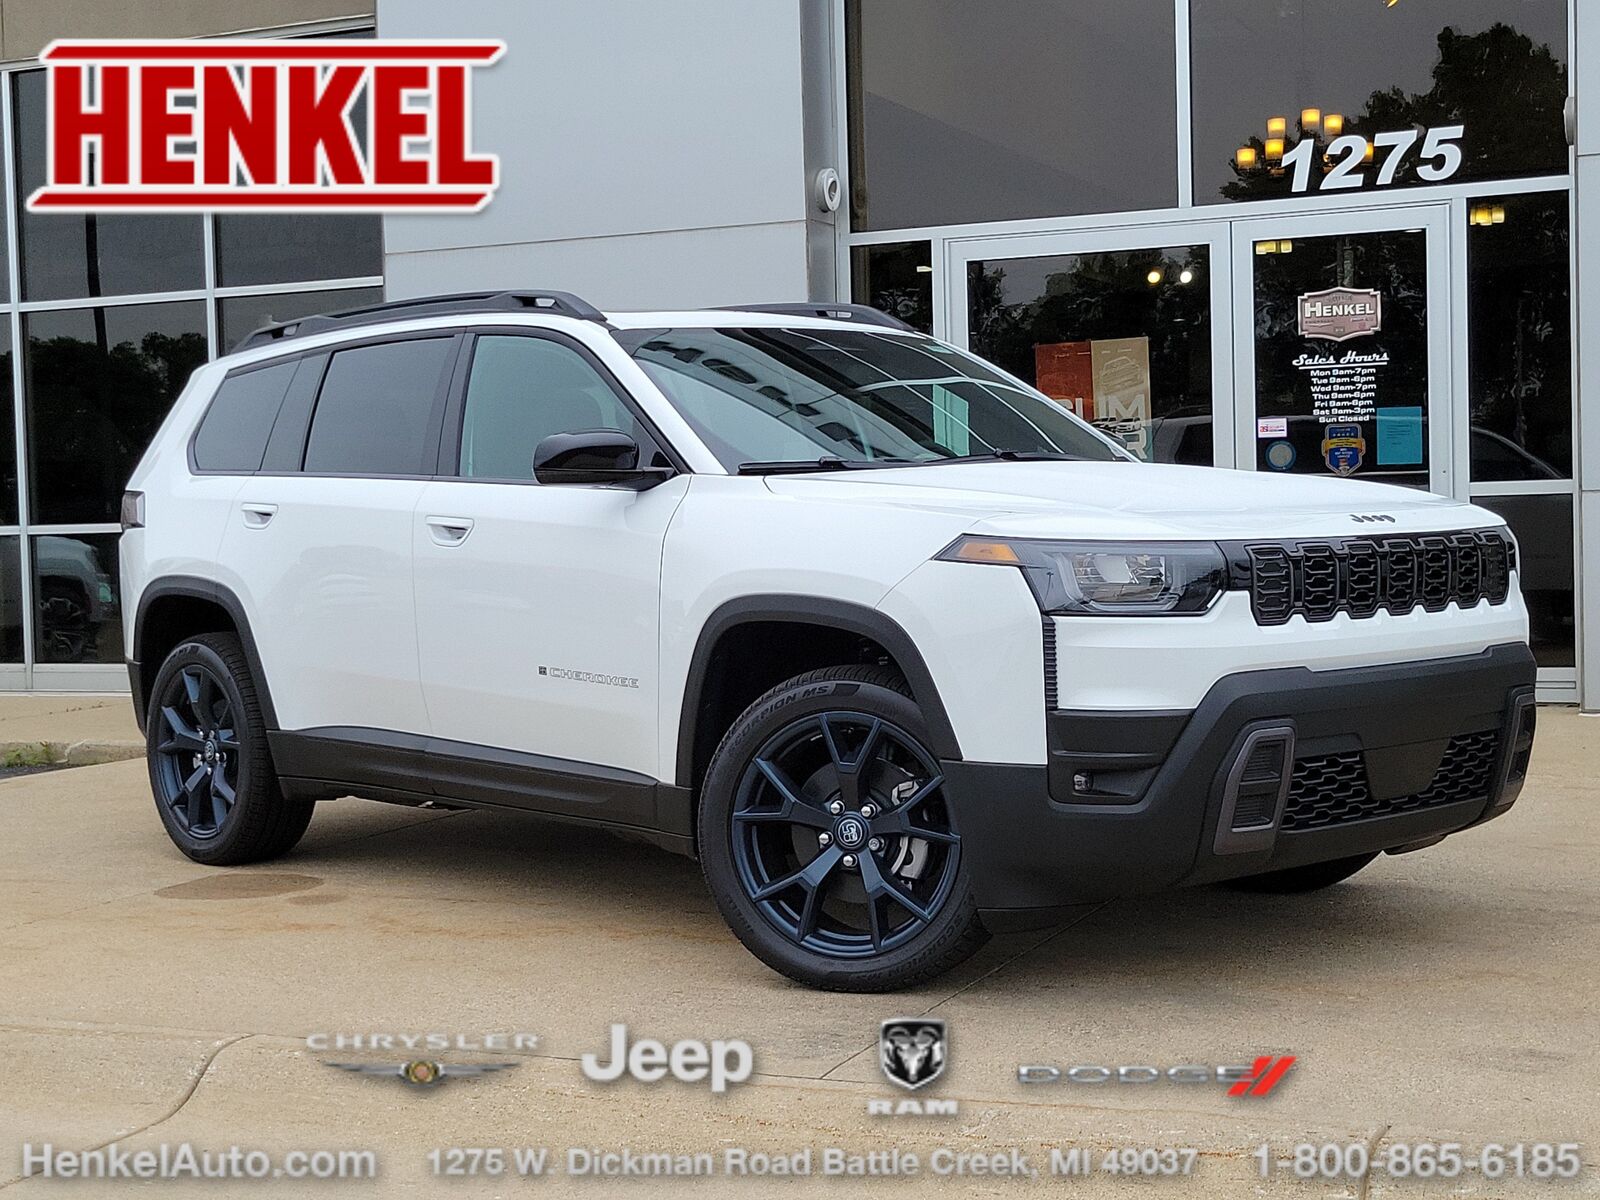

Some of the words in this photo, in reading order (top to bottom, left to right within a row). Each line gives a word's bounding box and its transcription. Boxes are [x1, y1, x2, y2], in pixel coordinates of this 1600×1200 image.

[1281, 125, 1465, 193] 1275
[1304, 302, 1375, 318] HENKEL
[1292, 354, 1336, 366] Sales
[1340, 350, 1390, 364] Hours
[1349, 514, 1396, 523] Jeep
[549, 667, 639, 689] CHEROKEE
[802, 685, 829, 698] MS
